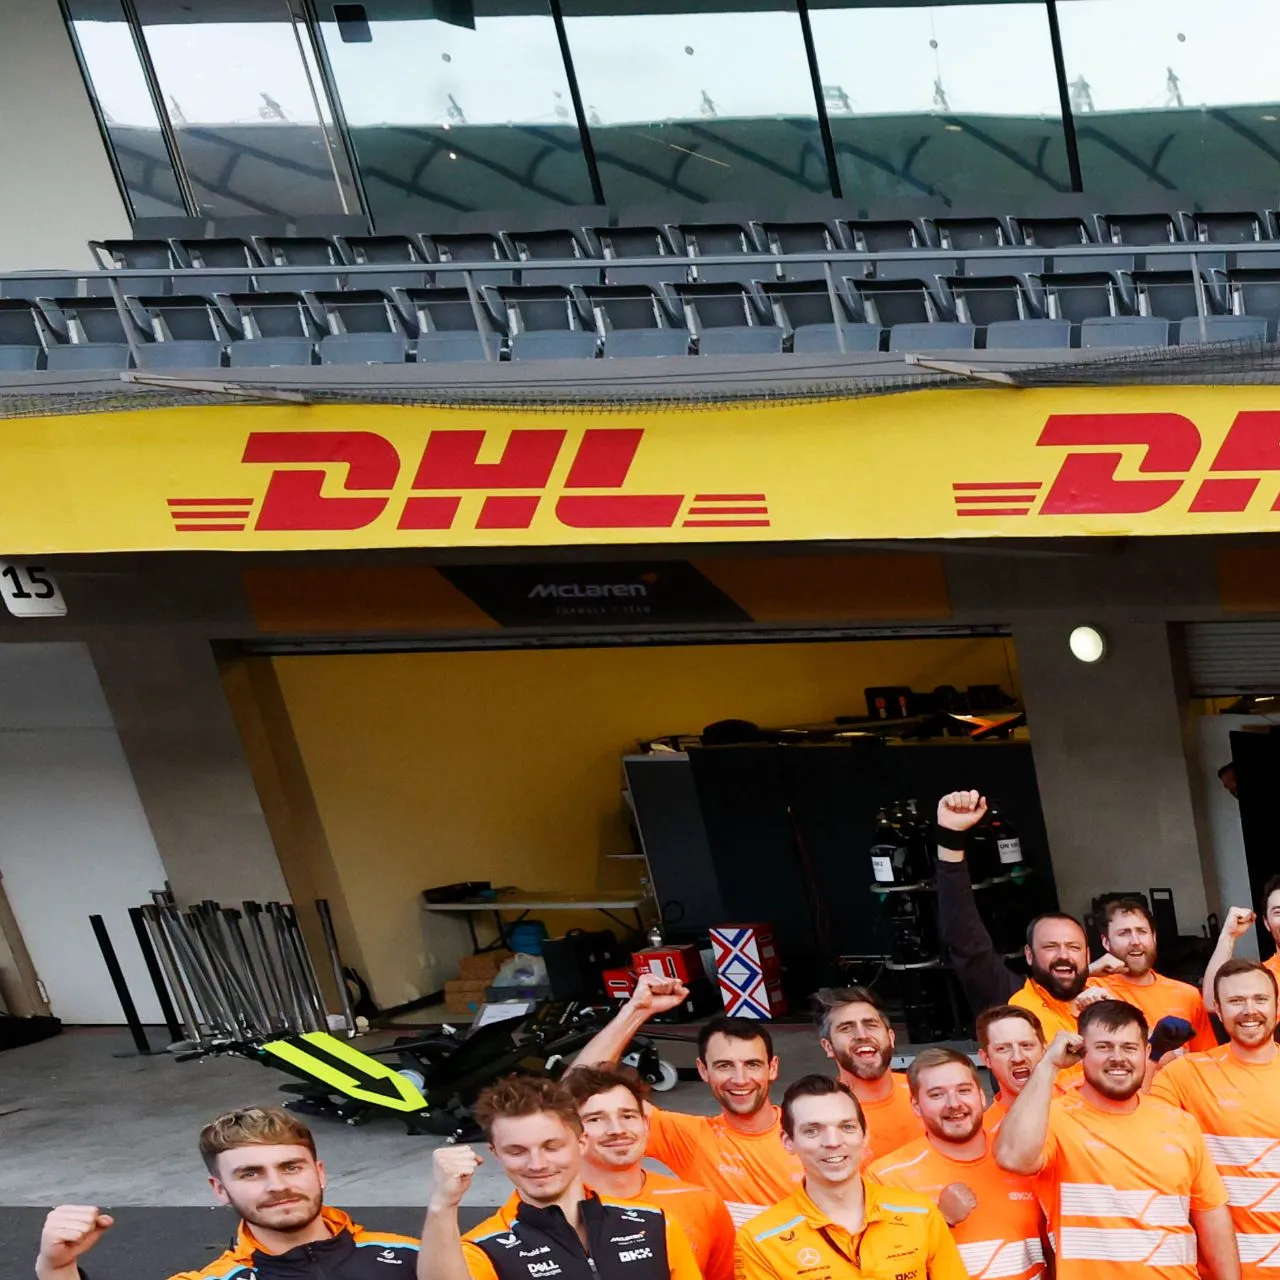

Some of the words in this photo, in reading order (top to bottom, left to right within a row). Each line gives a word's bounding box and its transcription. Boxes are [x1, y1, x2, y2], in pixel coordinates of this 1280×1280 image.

[241, 428, 685, 531] DHL
[2, 566, 55, 599] 15
[528, 582, 648, 599] McLaren
[618, 1247, 653, 1263] OKX
[527, 1260, 560, 1273] DELL
